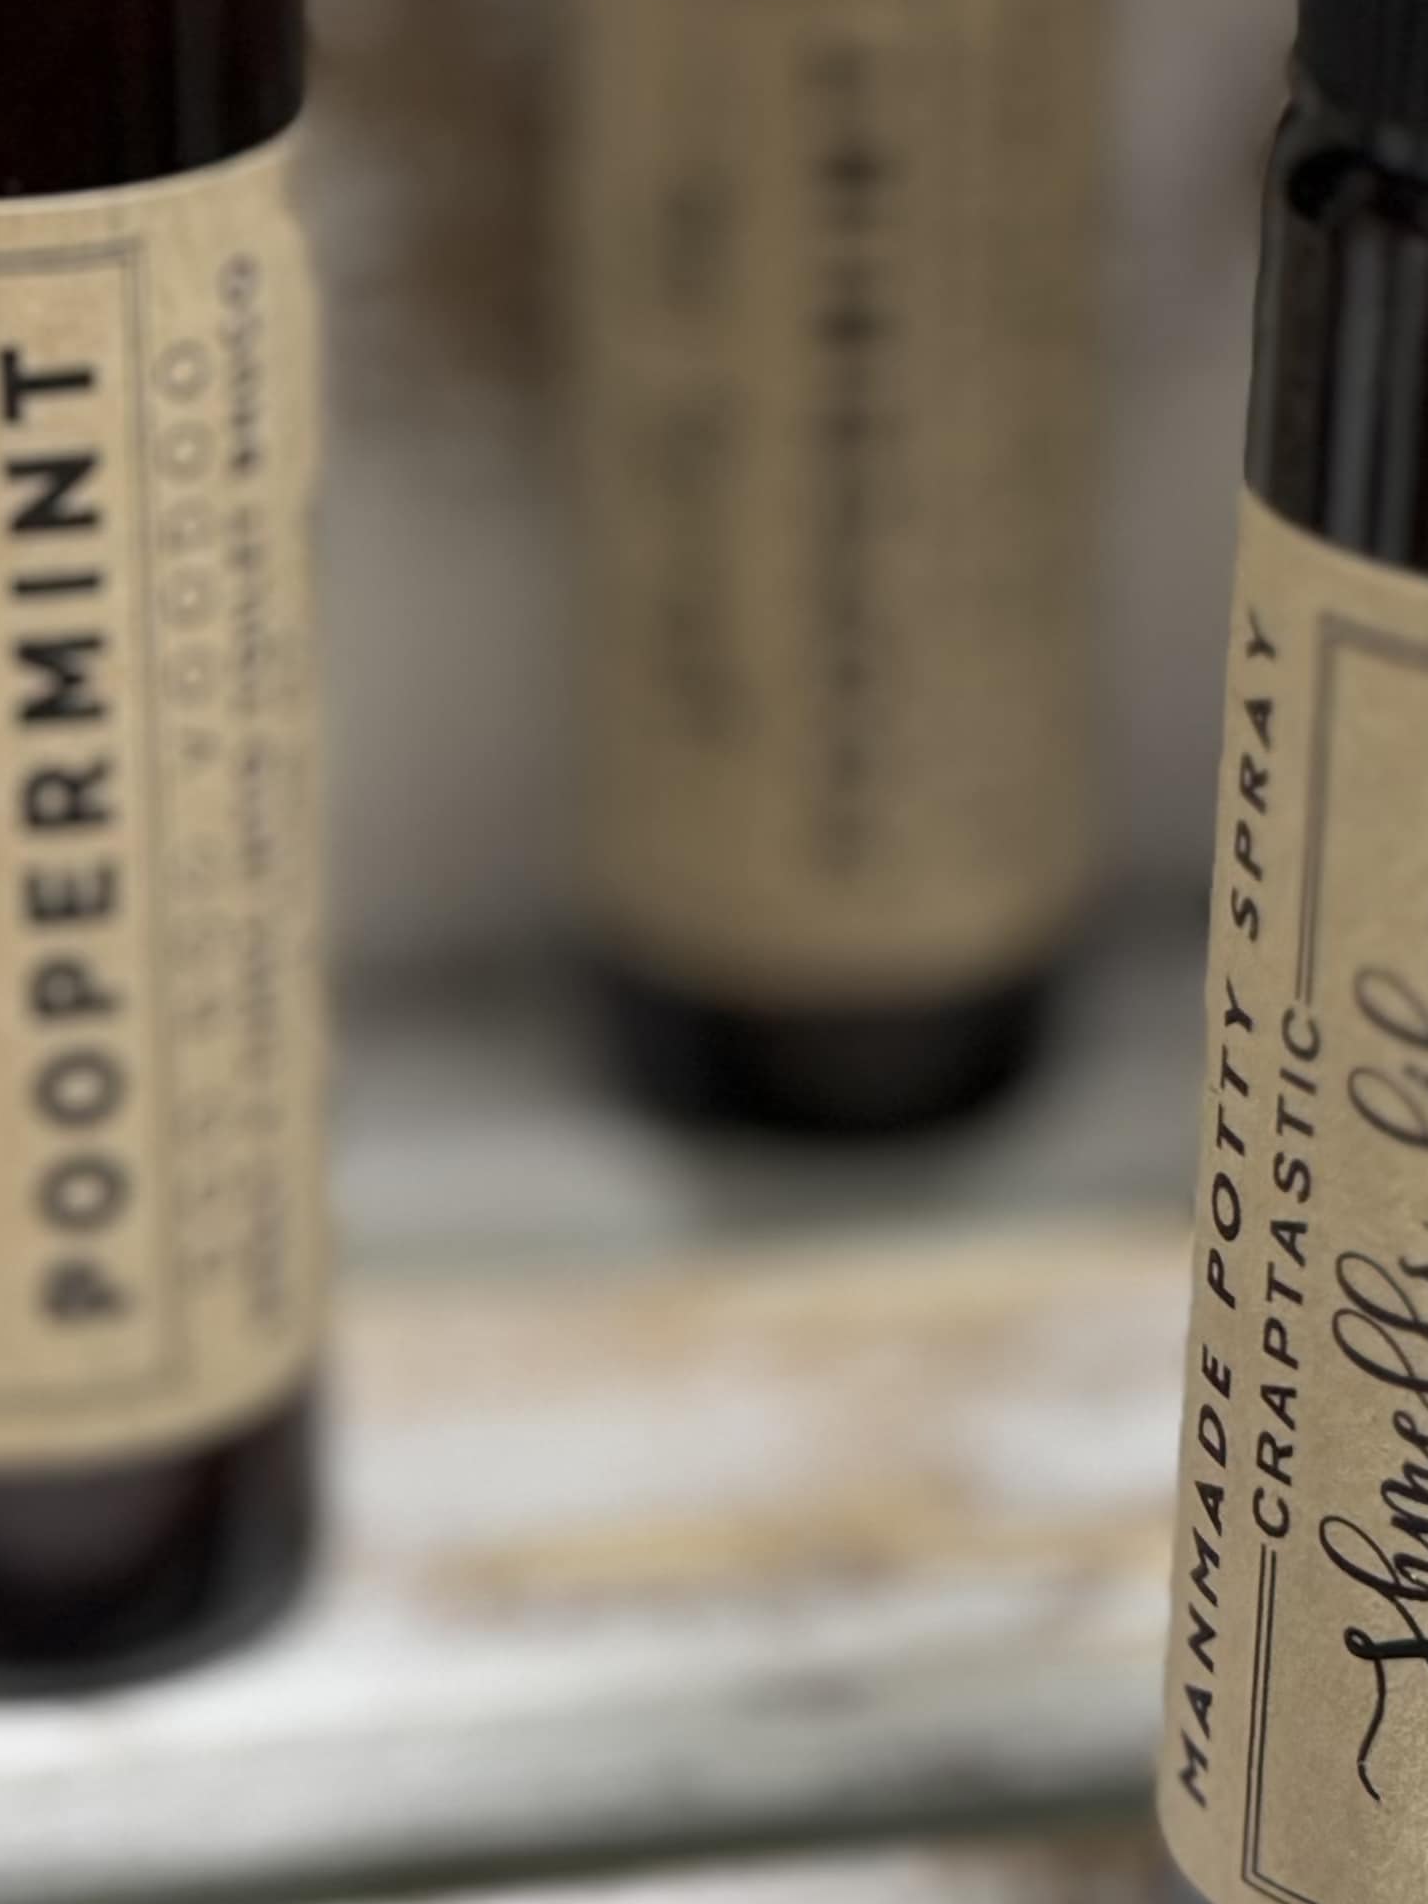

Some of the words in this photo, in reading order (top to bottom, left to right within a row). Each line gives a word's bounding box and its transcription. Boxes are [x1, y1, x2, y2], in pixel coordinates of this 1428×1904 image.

[1228, 604, 1277, 942] SPRAY
[1206, 975, 1255, 1310] POTTY
[1252, 1005, 1321, 1539] CRAPTASTIC
[1177, 1344, 1232, 1809] MANMADE
